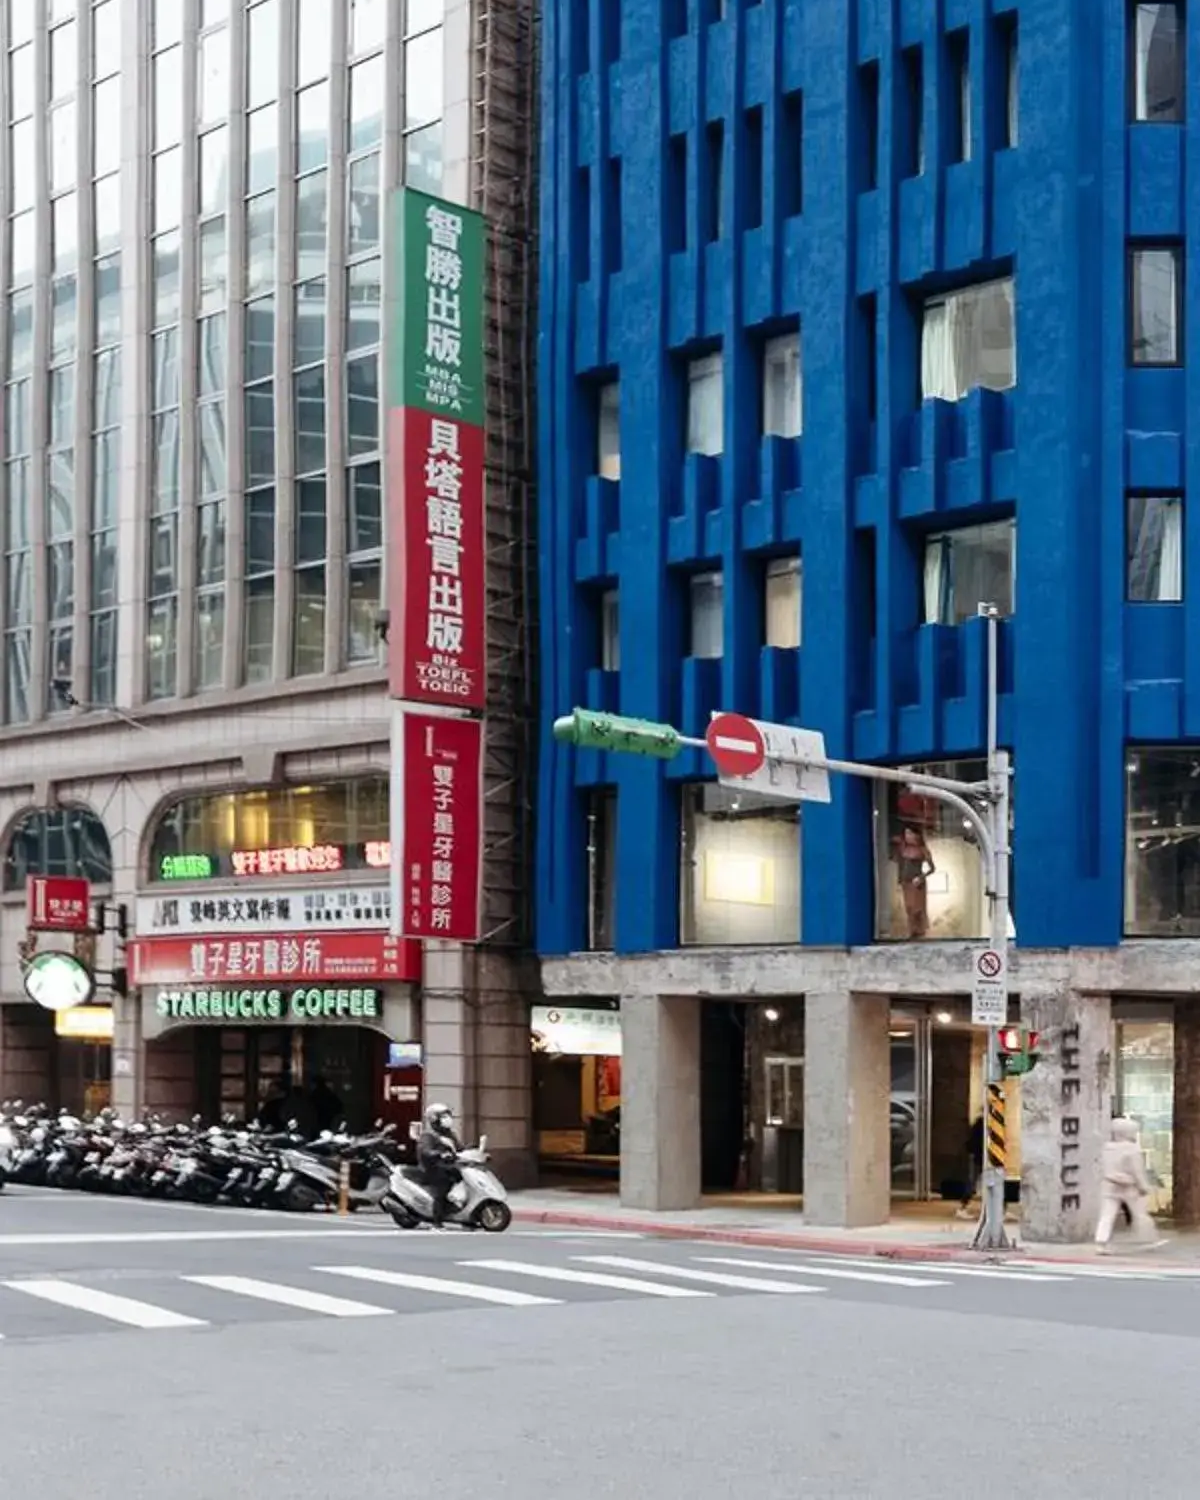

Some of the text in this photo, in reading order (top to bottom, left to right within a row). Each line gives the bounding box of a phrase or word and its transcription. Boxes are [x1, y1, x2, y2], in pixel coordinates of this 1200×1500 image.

[425, 205, 463, 367] 智勝出版
[424, 418, 464, 654] 貝塔語言出版
[416, 666, 472, 684] TOEFL
[418, 678, 470, 696] TOEIC
[430, 764, 454, 930] 雙子星牙醫診所
[156, 988, 377, 1018] STARBUCKS COFFEE
[190, 939, 321, 976] 雙子星牙醫診所
[1061, 1023, 1081, 1212] THE BLUE
